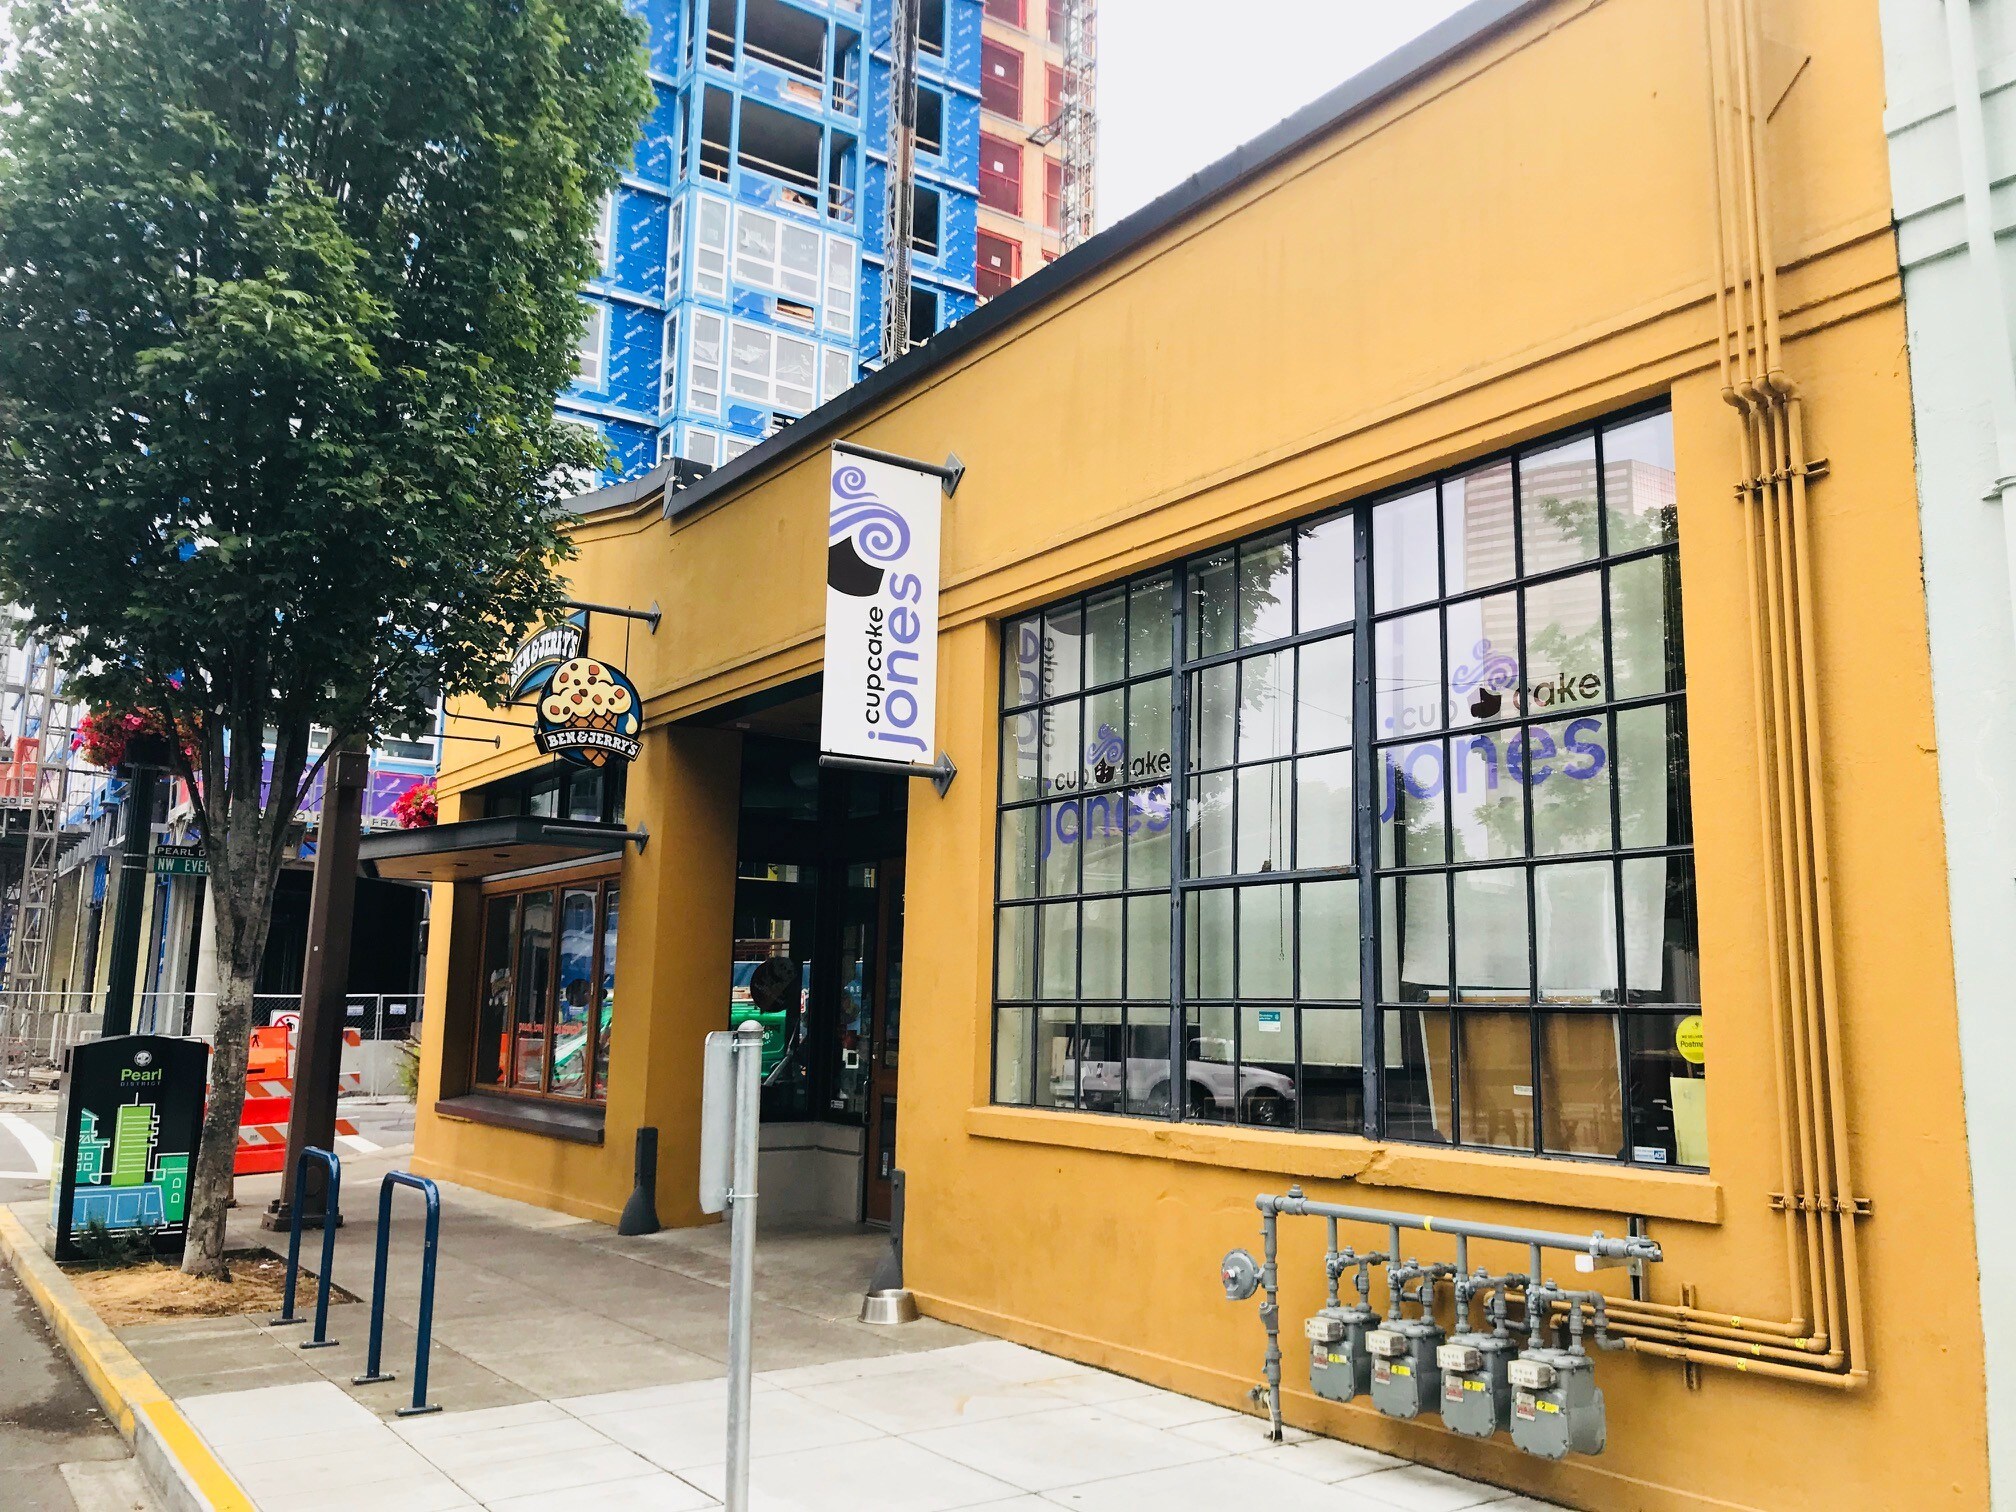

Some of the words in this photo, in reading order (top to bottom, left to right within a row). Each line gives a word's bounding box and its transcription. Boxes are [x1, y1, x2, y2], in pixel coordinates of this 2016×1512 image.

[866, 606, 885, 724] cupcake
[868, 572, 928, 752] jones
[1379, 716, 1607, 824] jones
[157, 846, 194, 856] PEARL
[1041, 779, 1171, 861] jones
[157, 858, 175, 871] NW
[184, 859, 211, 873] EVER
[120, 1068, 162, 1081] Pearl
